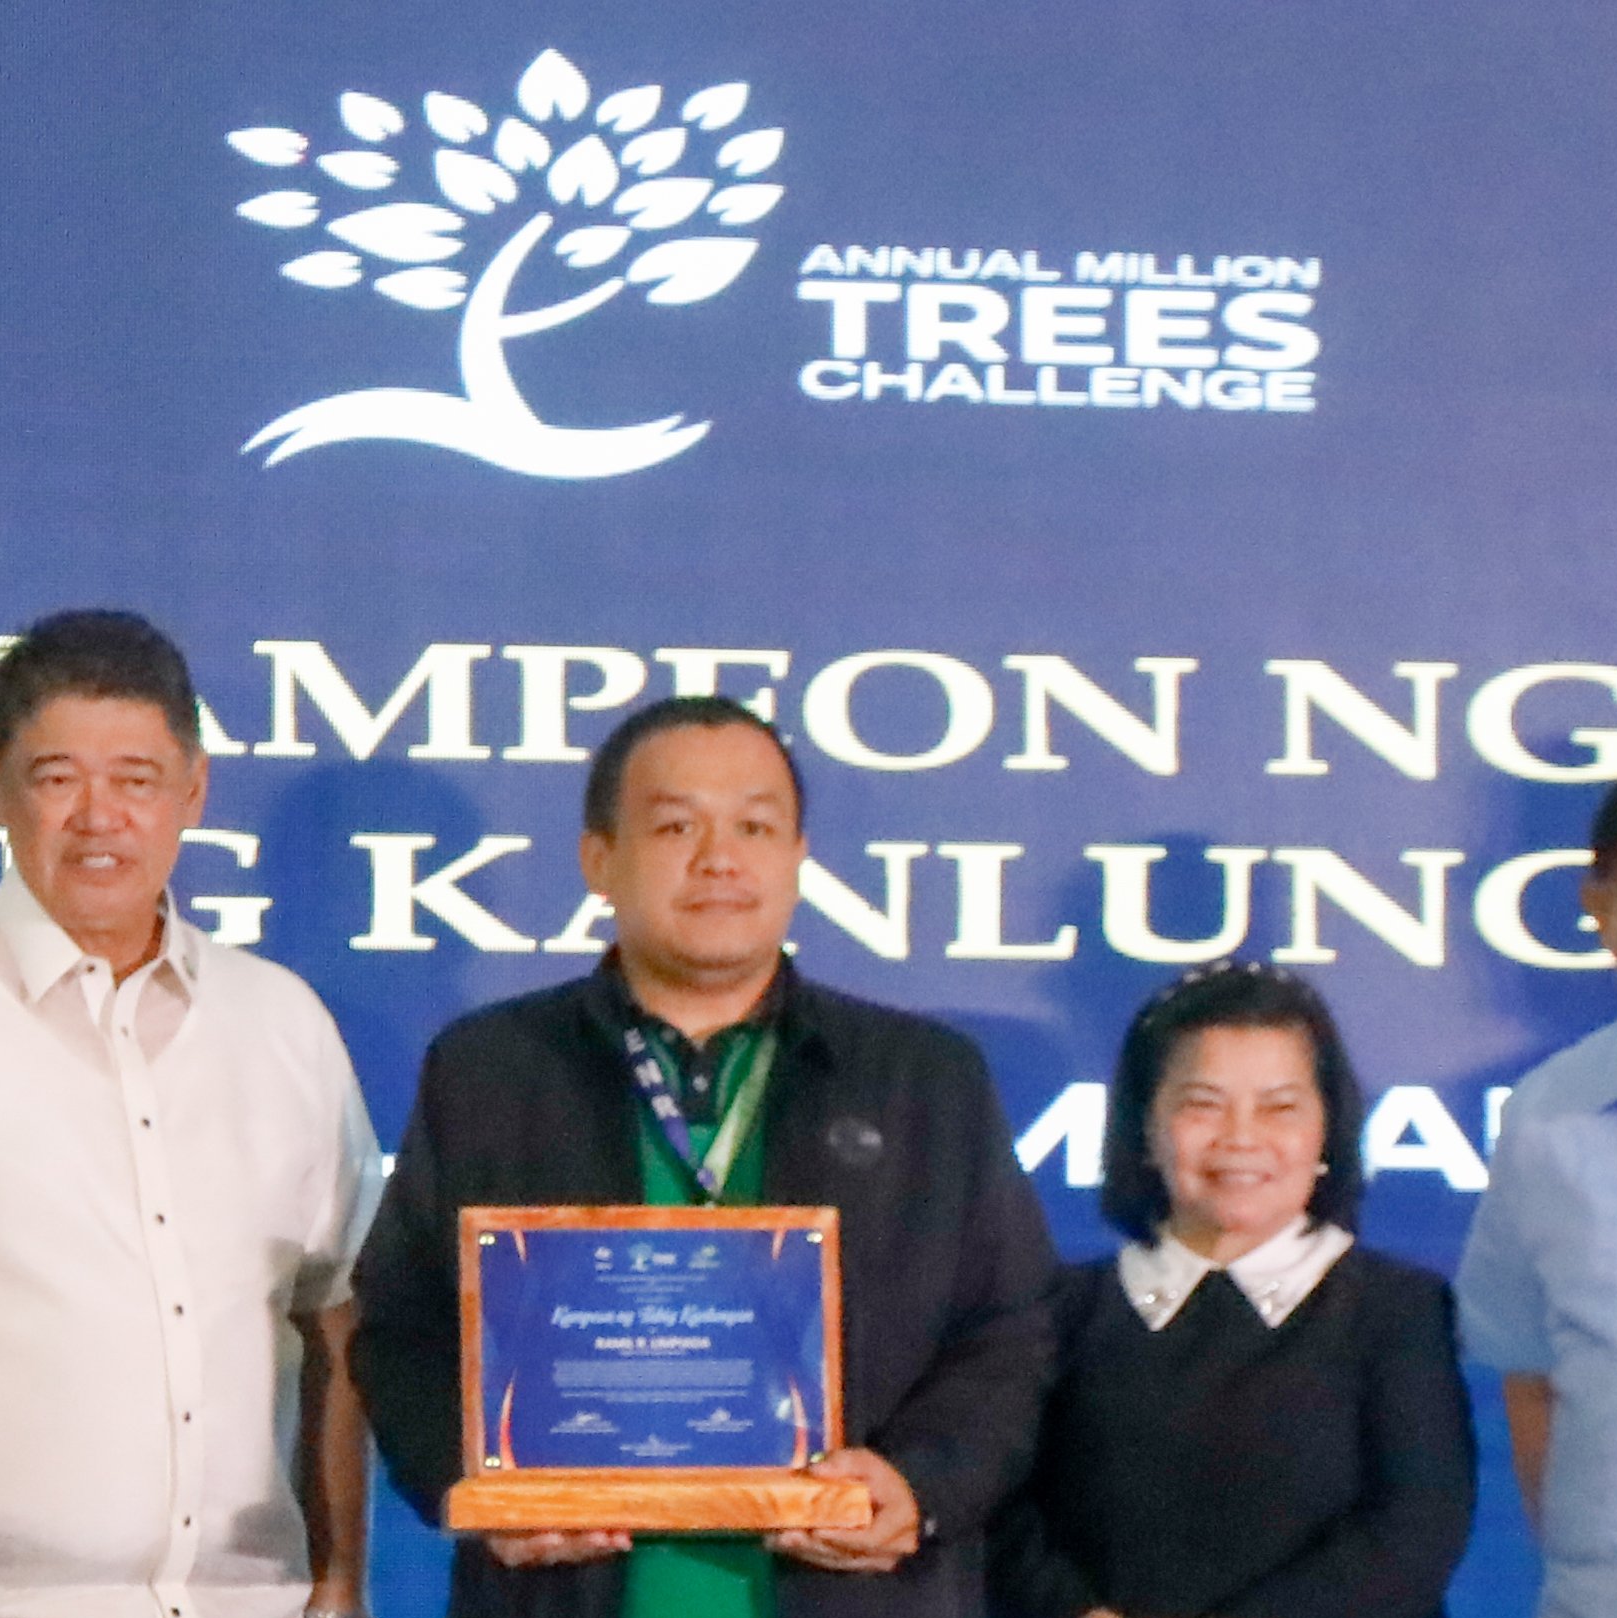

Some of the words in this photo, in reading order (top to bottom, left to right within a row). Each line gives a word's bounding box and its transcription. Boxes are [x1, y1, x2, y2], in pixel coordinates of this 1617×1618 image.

[799, 244, 1062, 281] ANNUAL
[1075, 251, 1321, 289] MILLION
[796, 281, 1321, 370] TREES
[798, 360, 1318, 412] CHALLENGE
